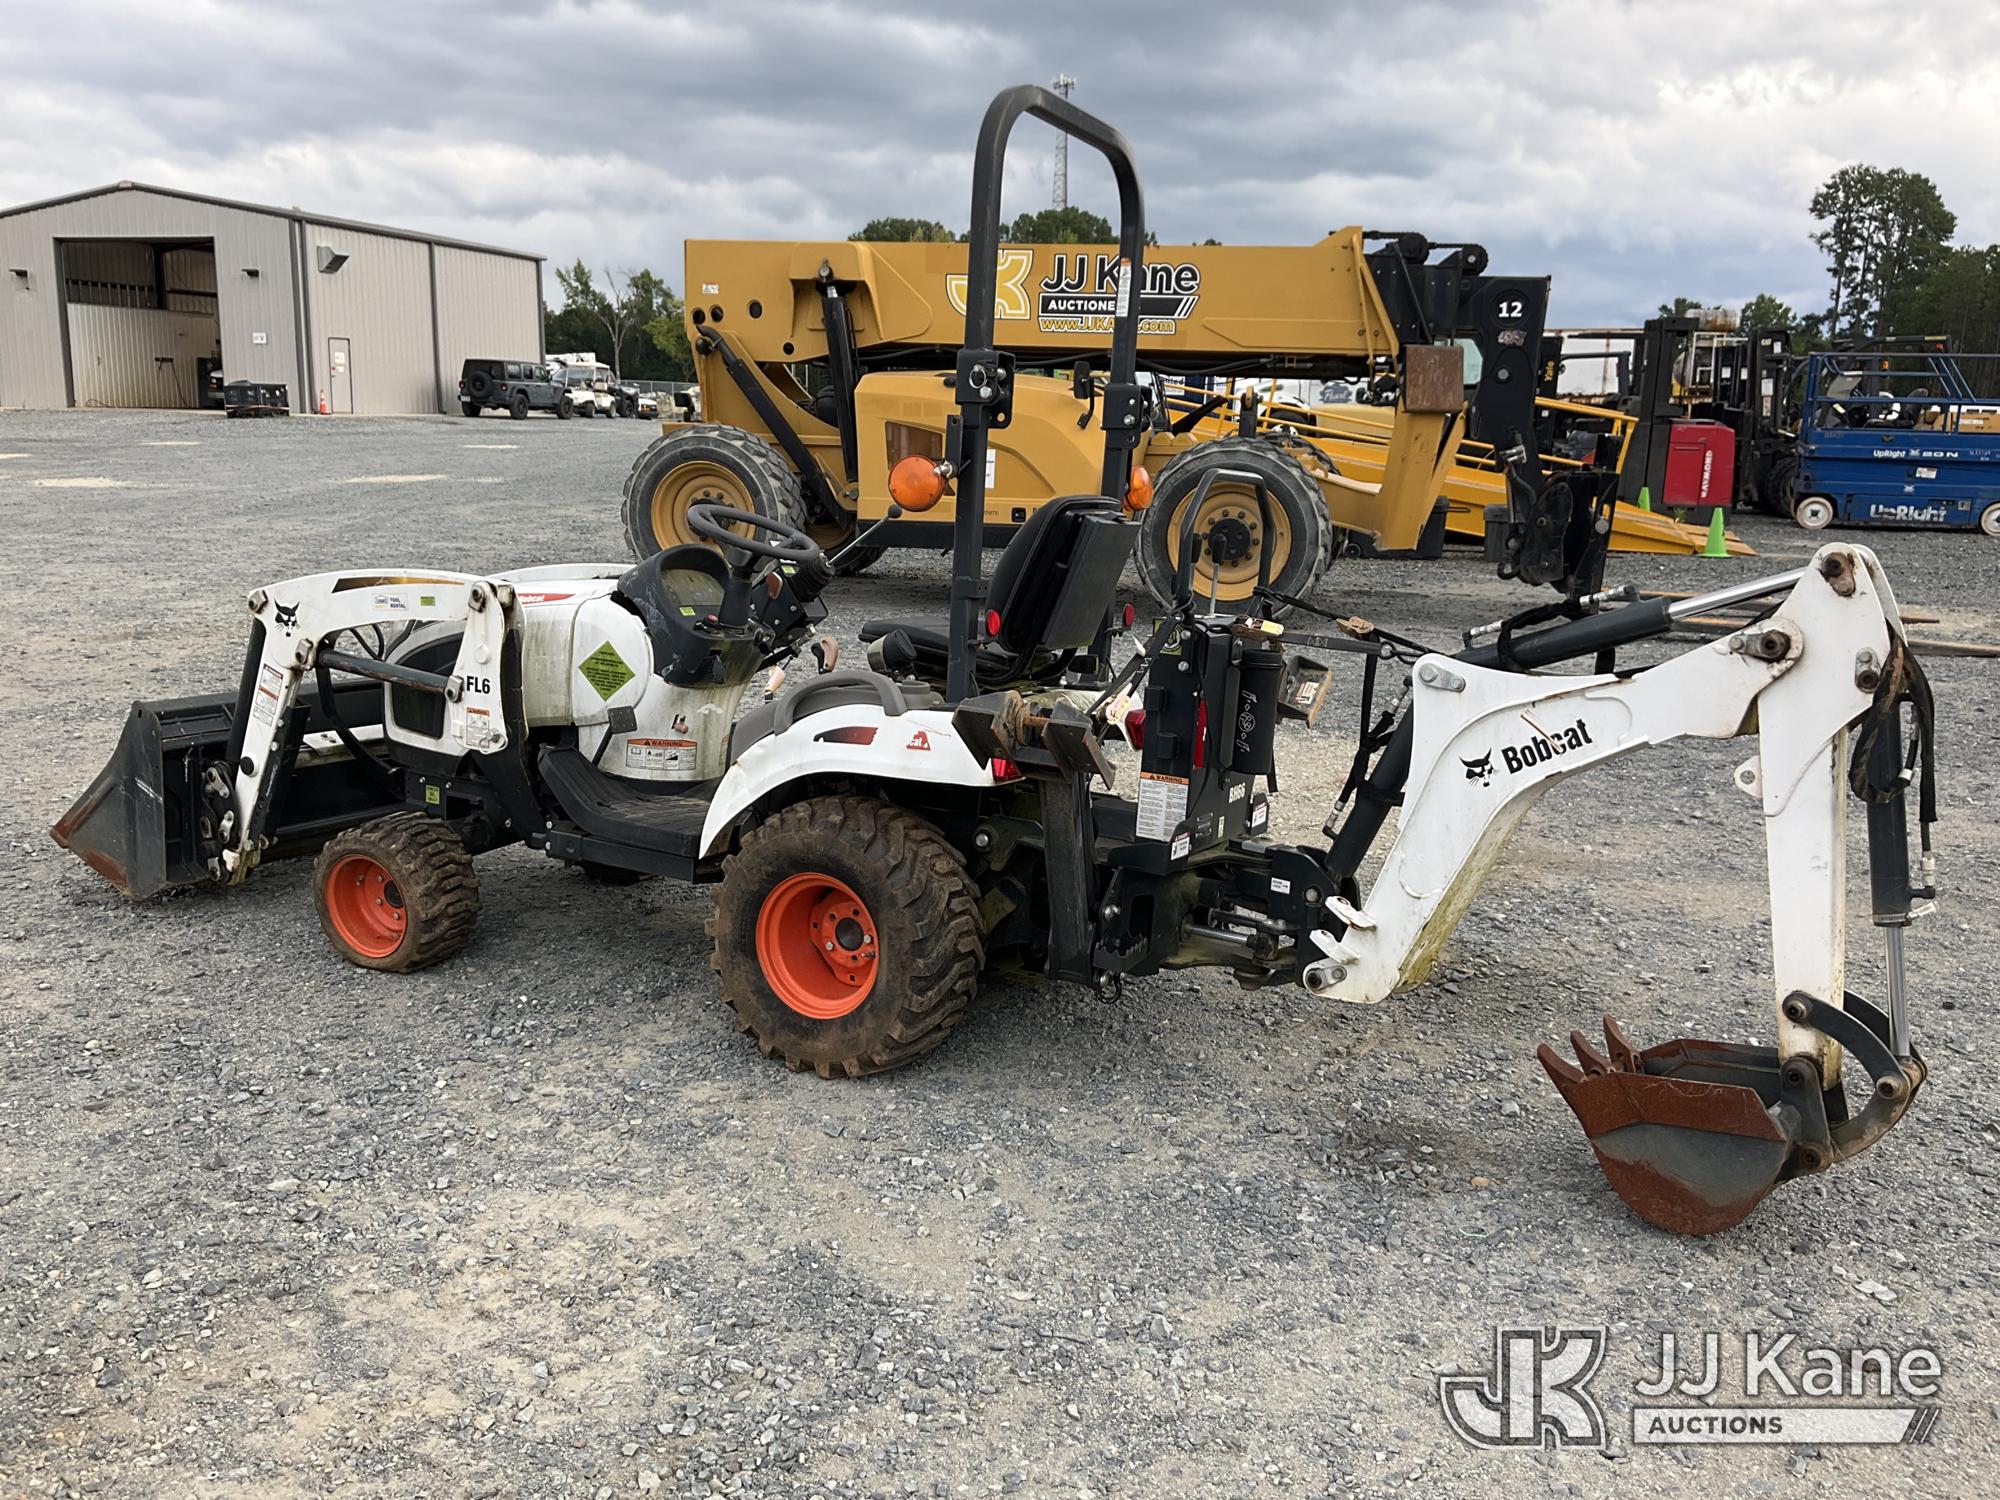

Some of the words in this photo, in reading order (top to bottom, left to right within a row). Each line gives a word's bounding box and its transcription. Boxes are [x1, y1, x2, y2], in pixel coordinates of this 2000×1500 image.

[1095, 254, 1201, 294] Kne
[1498, 301, 1522, 317] 12
[1700, 450, 1713, 498] RAYMOND
[466, 675, 491, 695] FL6
[1501, 719, 1593, 774] Bobcat
[1156, 775, 1183, 783] WARNING
